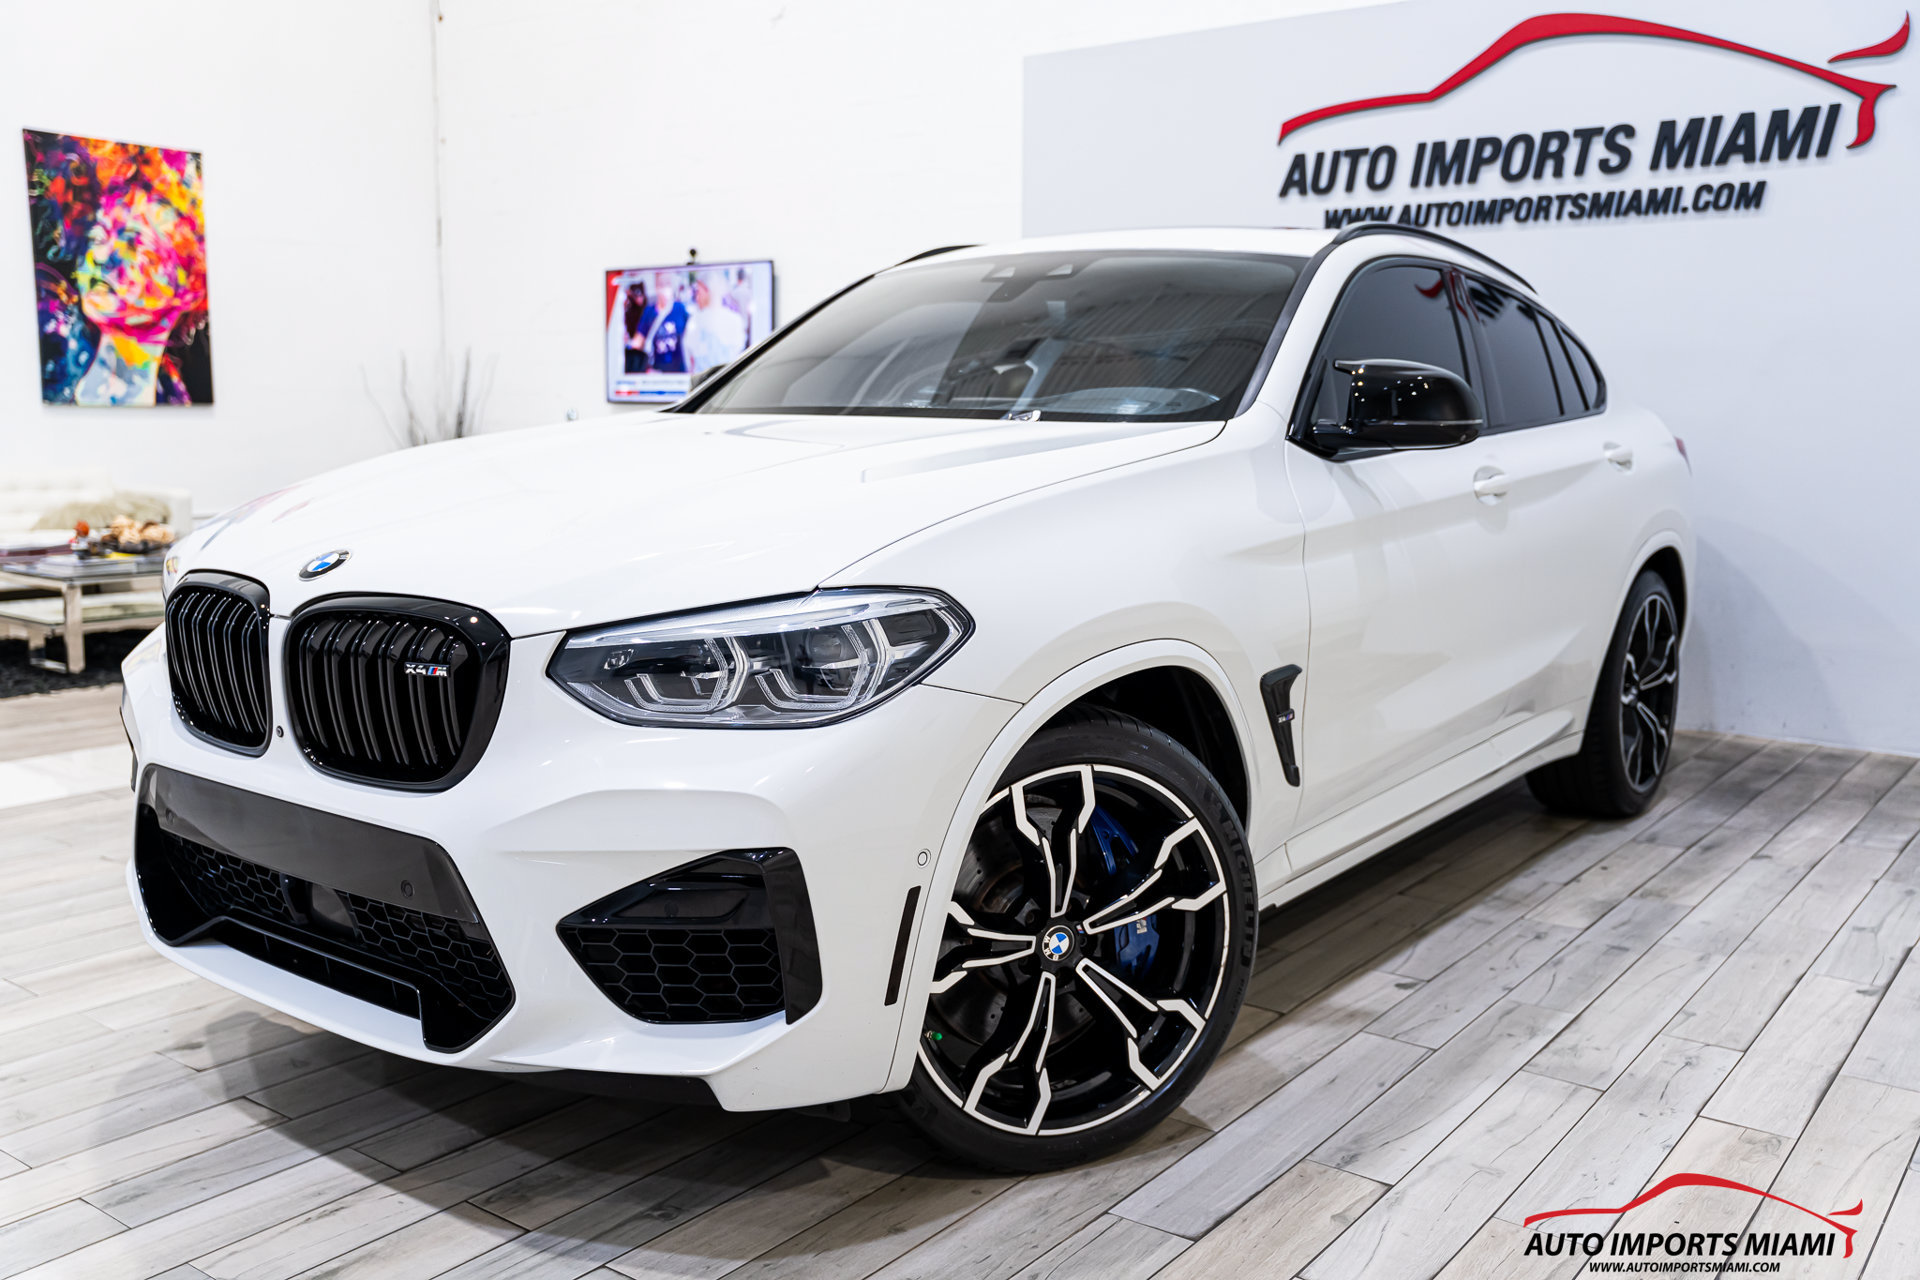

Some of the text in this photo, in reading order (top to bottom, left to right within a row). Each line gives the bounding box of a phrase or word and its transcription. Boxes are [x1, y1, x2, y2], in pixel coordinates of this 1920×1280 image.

[1280, 103, 1842, 197] AUTO IMPORTS MIAMI
